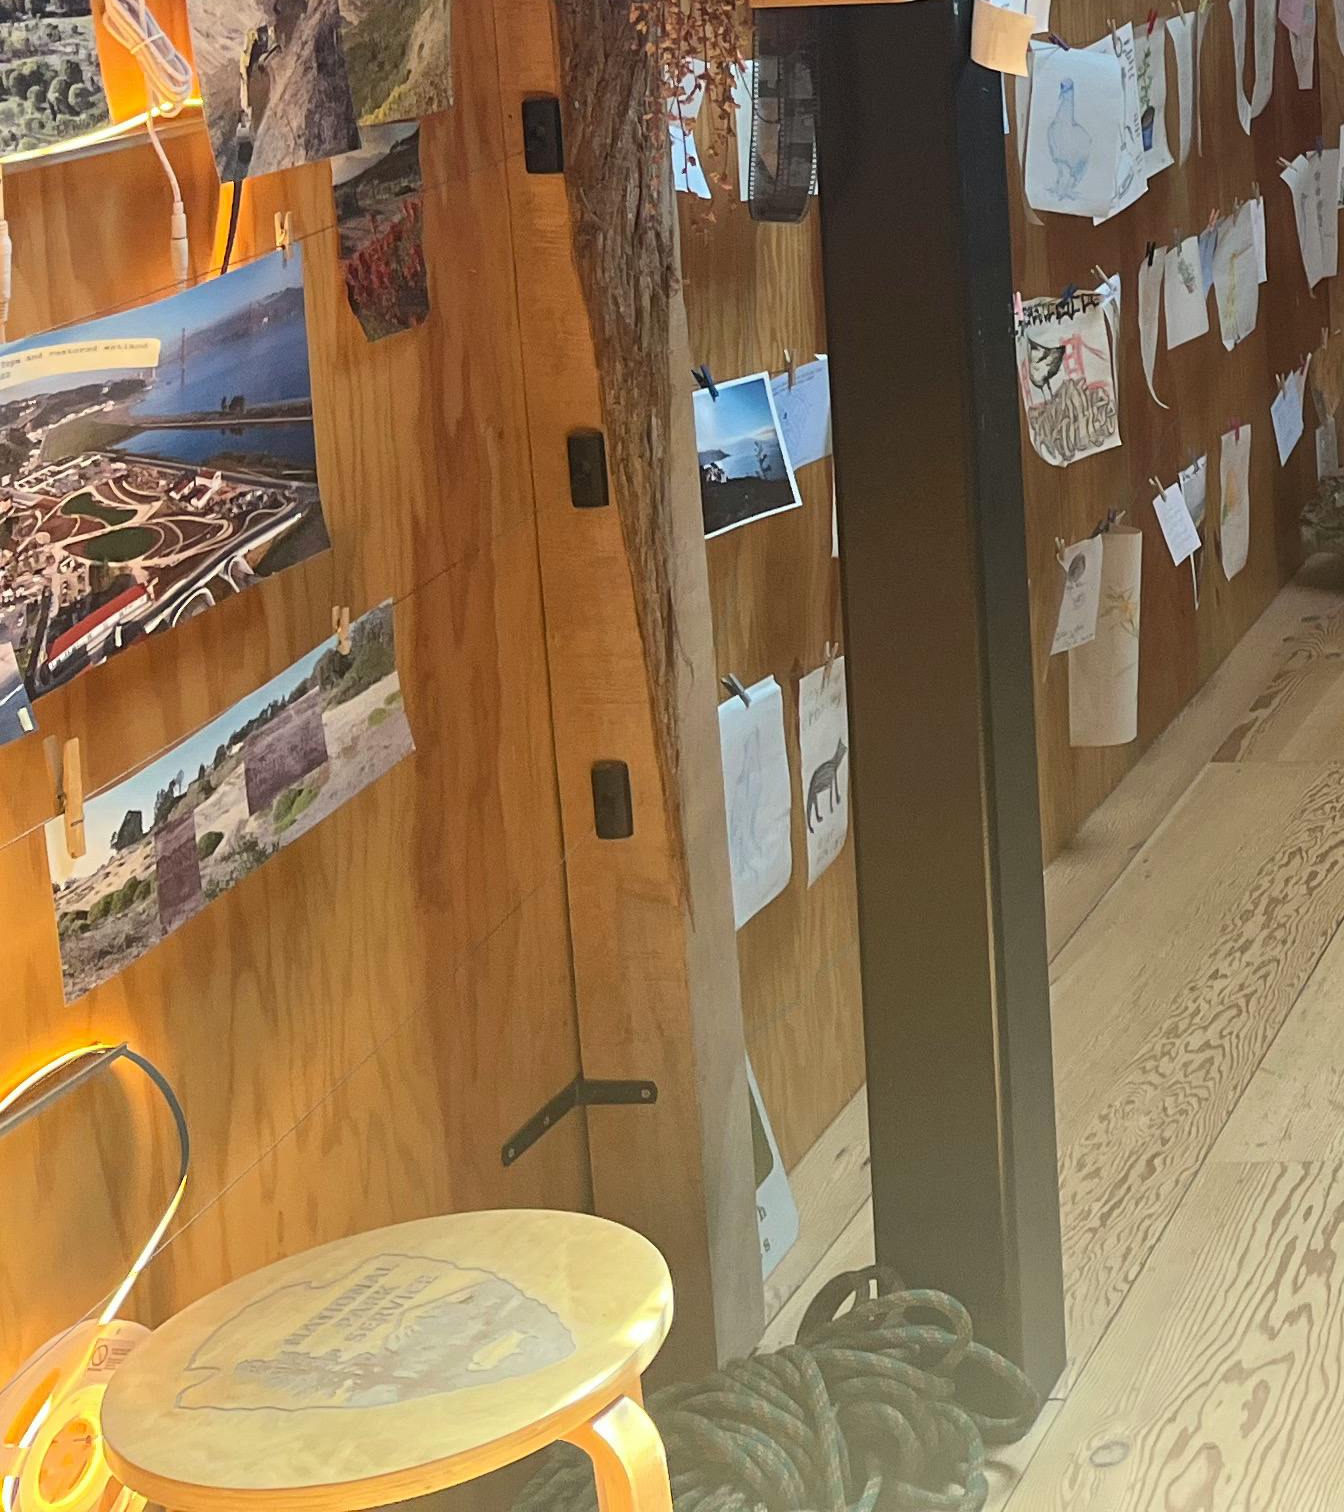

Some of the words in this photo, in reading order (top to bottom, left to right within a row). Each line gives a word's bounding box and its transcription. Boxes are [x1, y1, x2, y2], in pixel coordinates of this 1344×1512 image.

[283, 1264, 398, 1345] NATIONAL
[336, 1286, 401, 1328] PARK
[344, 1274, 440, 1342] SERVICE
